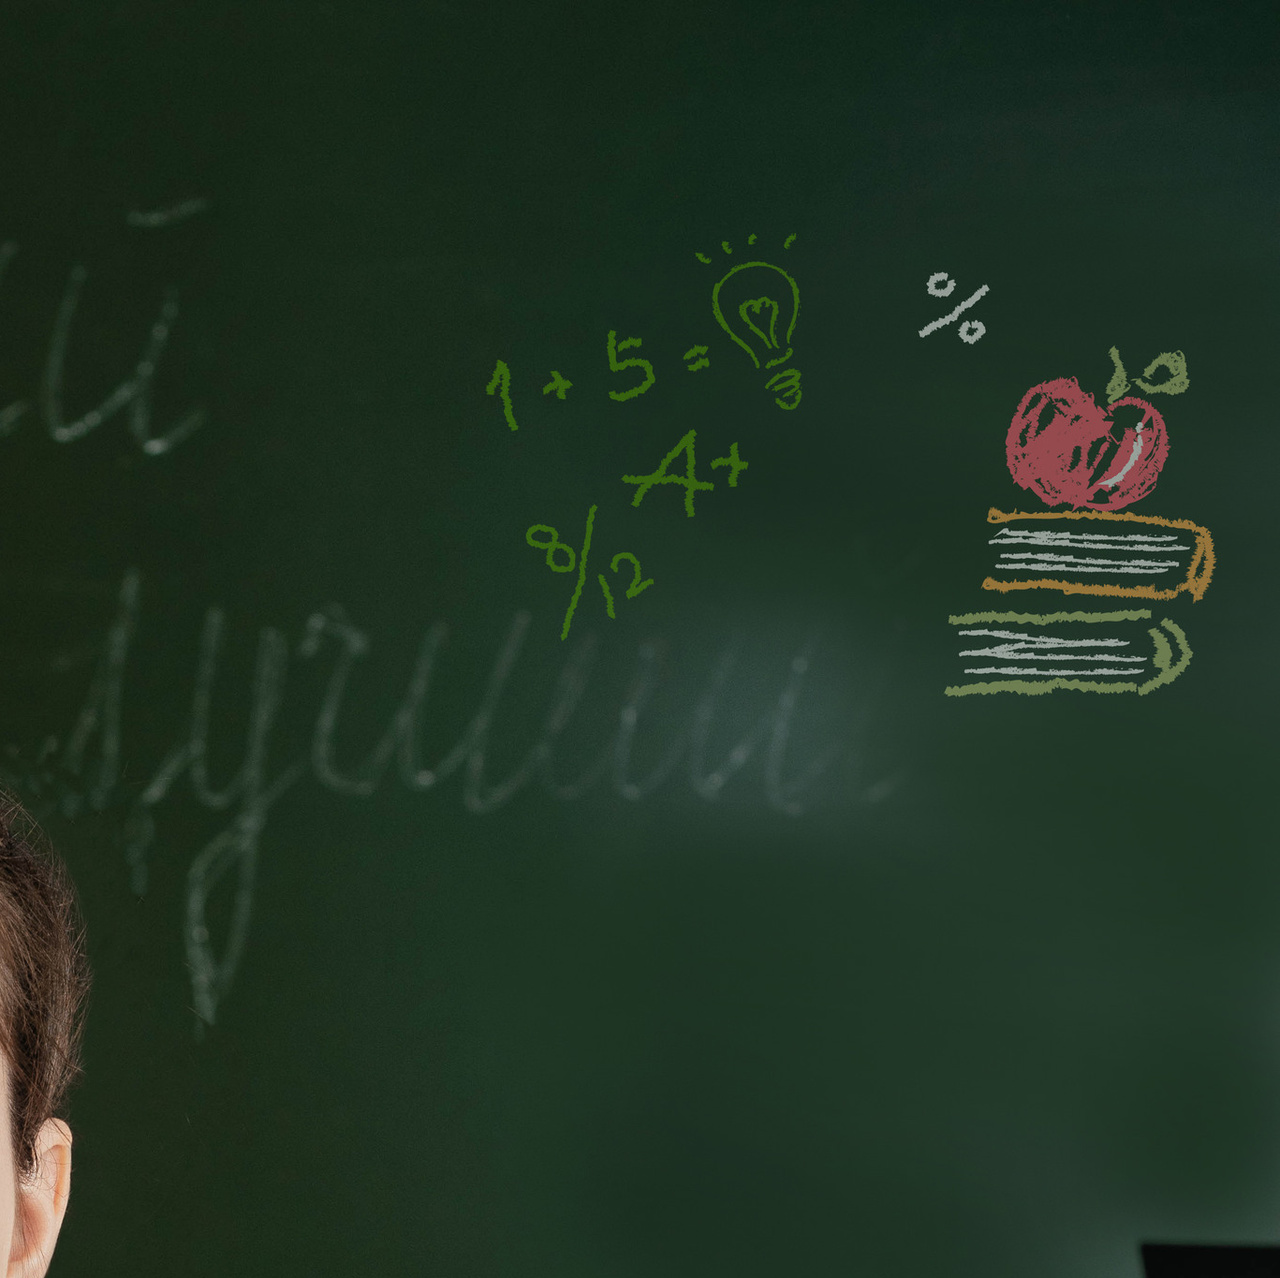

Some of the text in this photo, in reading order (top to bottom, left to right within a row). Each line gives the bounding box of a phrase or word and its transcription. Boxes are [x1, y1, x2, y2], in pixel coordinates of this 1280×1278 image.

[919, 271, 990, 344] %
[486, 330, 710, 431] 1 + 5 =
[621, 430, 749, 517] A+
[525, 505, 655, 641] 8/12
